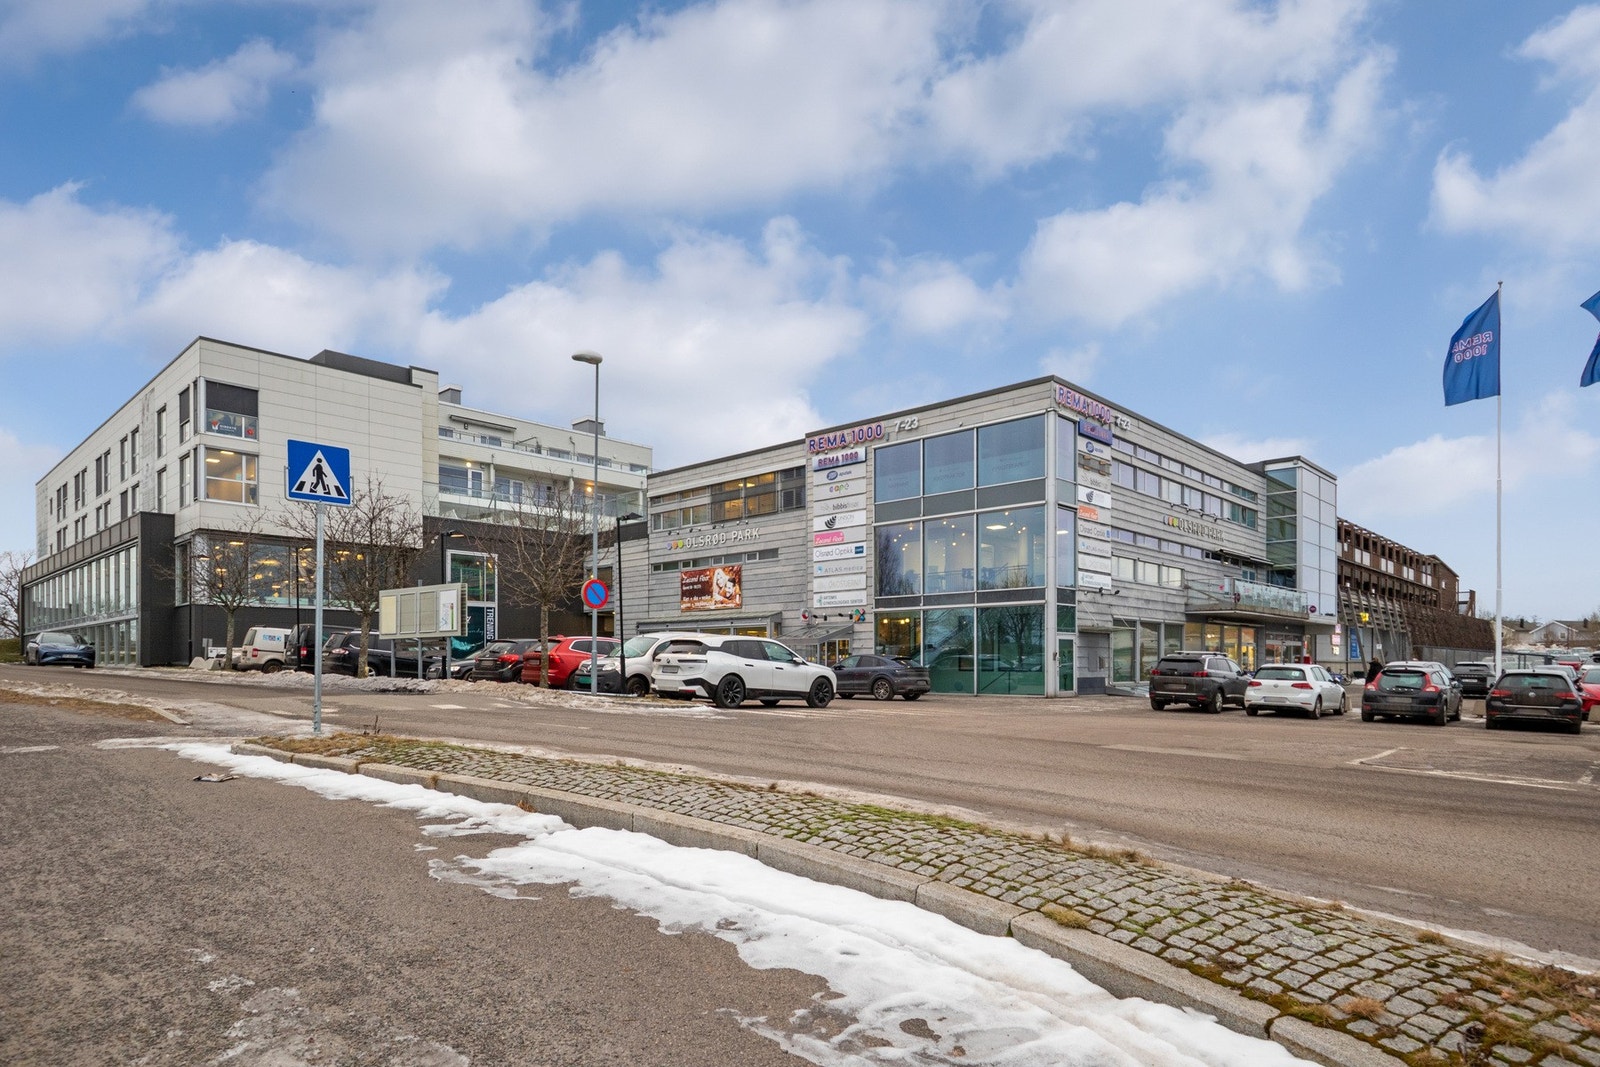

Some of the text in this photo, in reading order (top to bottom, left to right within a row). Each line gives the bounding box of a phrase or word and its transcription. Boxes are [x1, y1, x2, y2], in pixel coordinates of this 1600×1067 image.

[1057, 384, 1111, 423] REMA 1000
[894, 416, 919, 432] 7-23
[808, 422, 885, 454] REMA 1000
[818, 451, 859, 467] REMA 1000
[732, 527, 760, 542] PARK
[486, 607, 495, 640] TRENING
